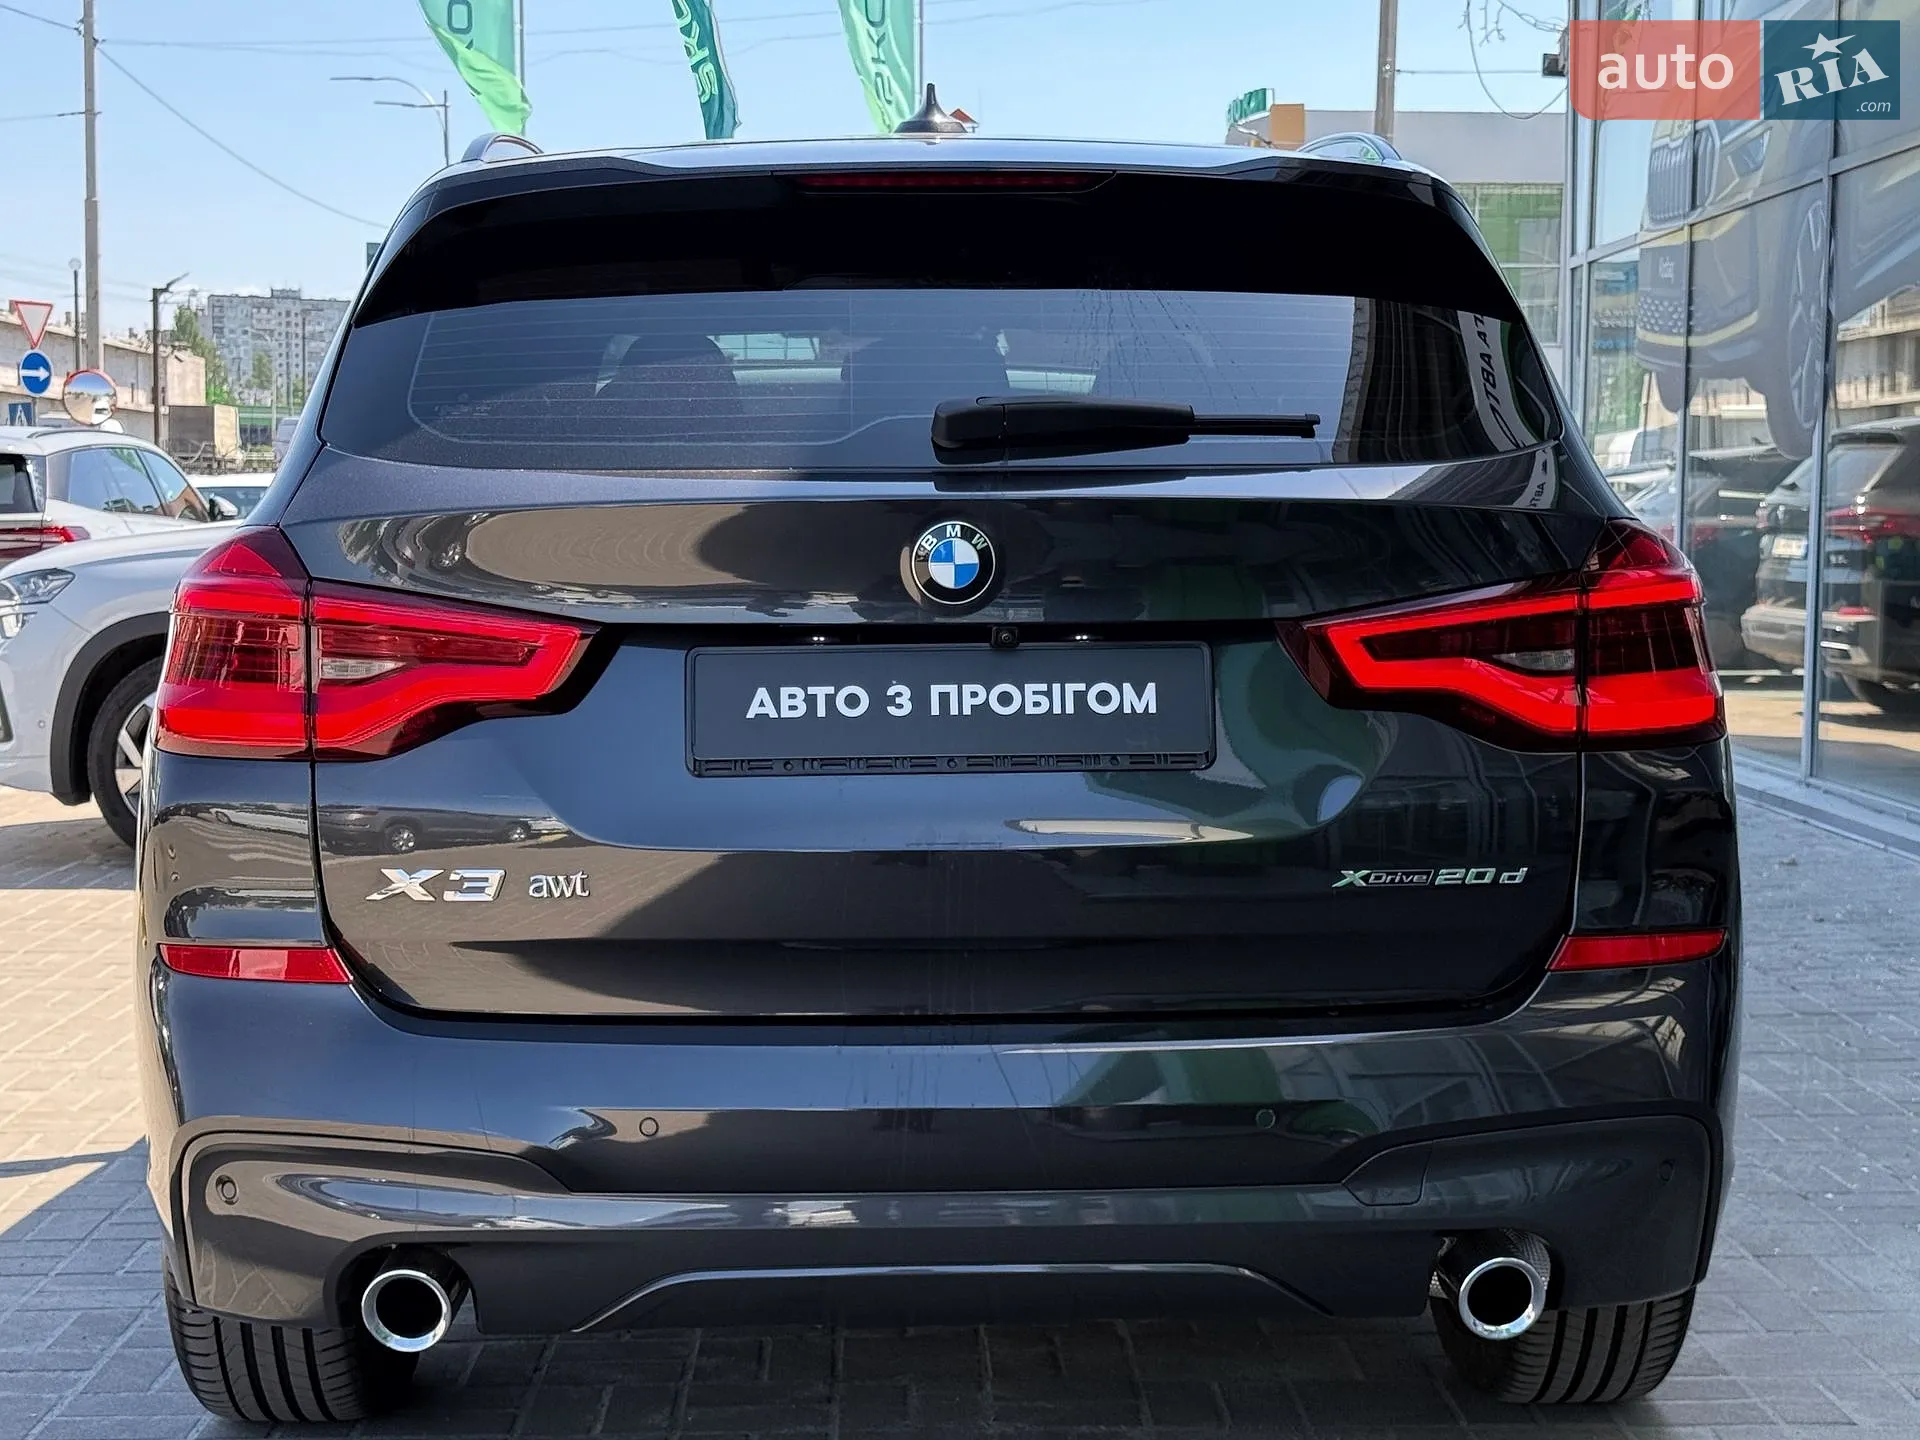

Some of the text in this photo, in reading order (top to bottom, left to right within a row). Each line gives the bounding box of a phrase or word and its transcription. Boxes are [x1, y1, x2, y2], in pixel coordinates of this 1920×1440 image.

[920, 524, 989, 551] BMW
[746, 685, 869, 719] АВТО
[931, 682, 1157, 715] ПРОБІГОМ
[365, 868, 591, 901] X3 awt
